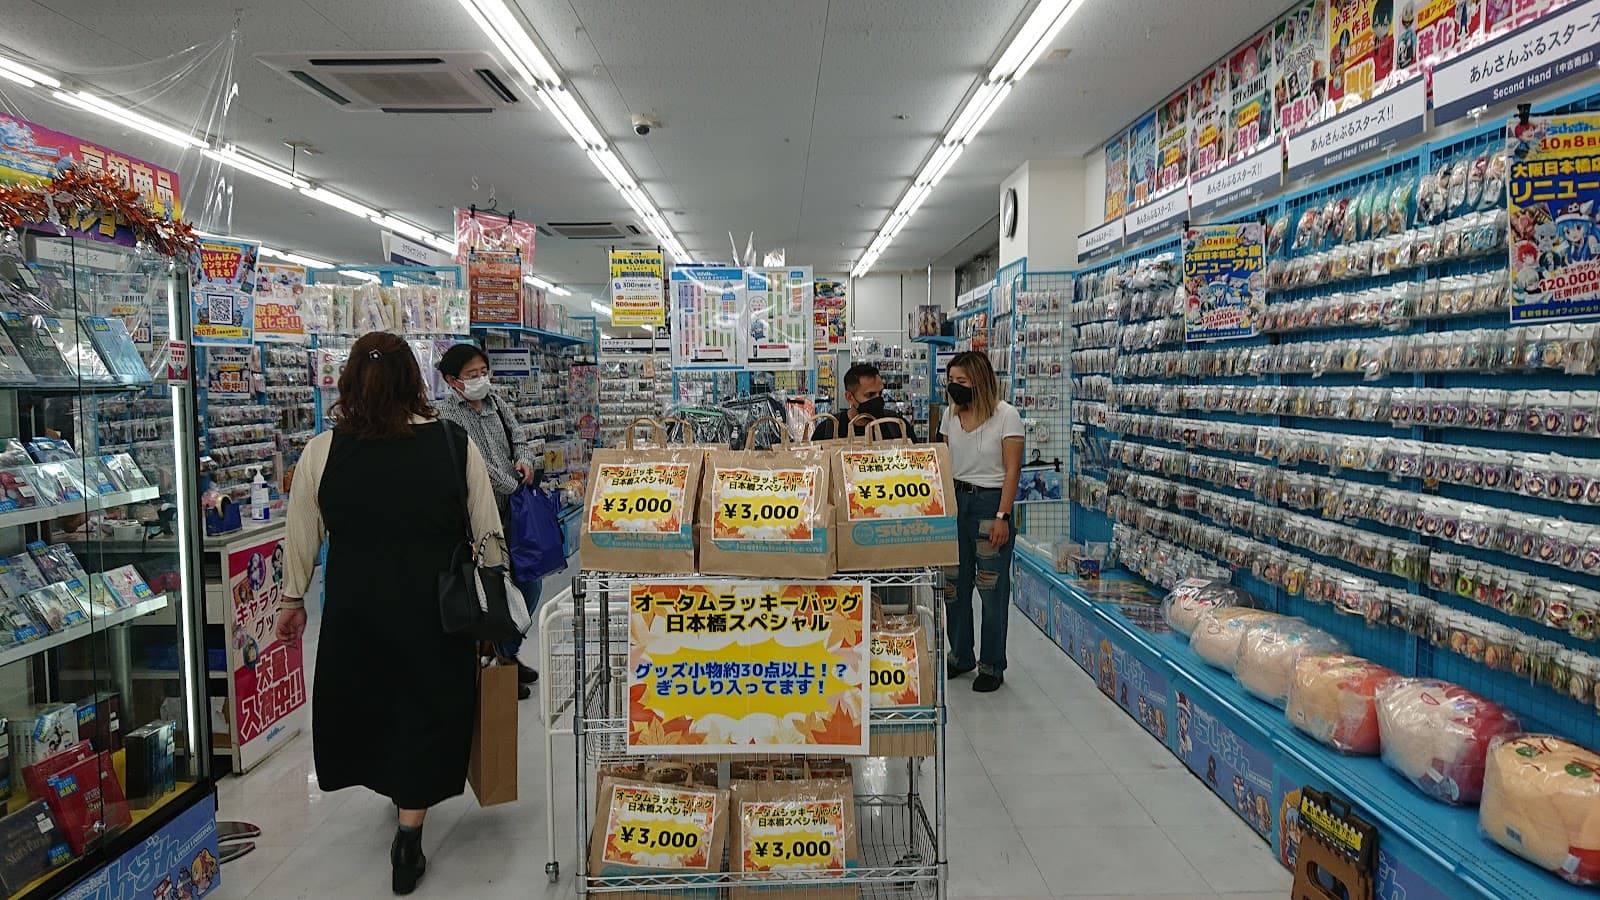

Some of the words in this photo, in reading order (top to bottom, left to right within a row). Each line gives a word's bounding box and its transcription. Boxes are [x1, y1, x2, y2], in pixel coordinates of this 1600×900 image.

[1493, 78, 1524, 100] Second
[1527, 67, 1552, 83] Hand
[1540, 135, 1600, 150] 10月8日
[858, 482, 931, 501] ¥3,000
[602, 496, 672, 514] ¥3,000
[723, 503, 799, 521] ¥3,000
[236, 582, 283, 626] キャラク
[635, 593, 861, 613] オータムラッキーバッグ
[254, 607, 281, 641] グッ
[666, 613, 830, 633] 日本橋スペシャル
[656, 680, 825, 696] ぎっしり入ってます！
[616, 790, 713, 810] オータムラッキーバッグ
[758, 816, 828, 827] 日本橋スペシャル
[621, 825, 698, 849] ¥3,000
[755, 840, 832, 860] ¥3,000
